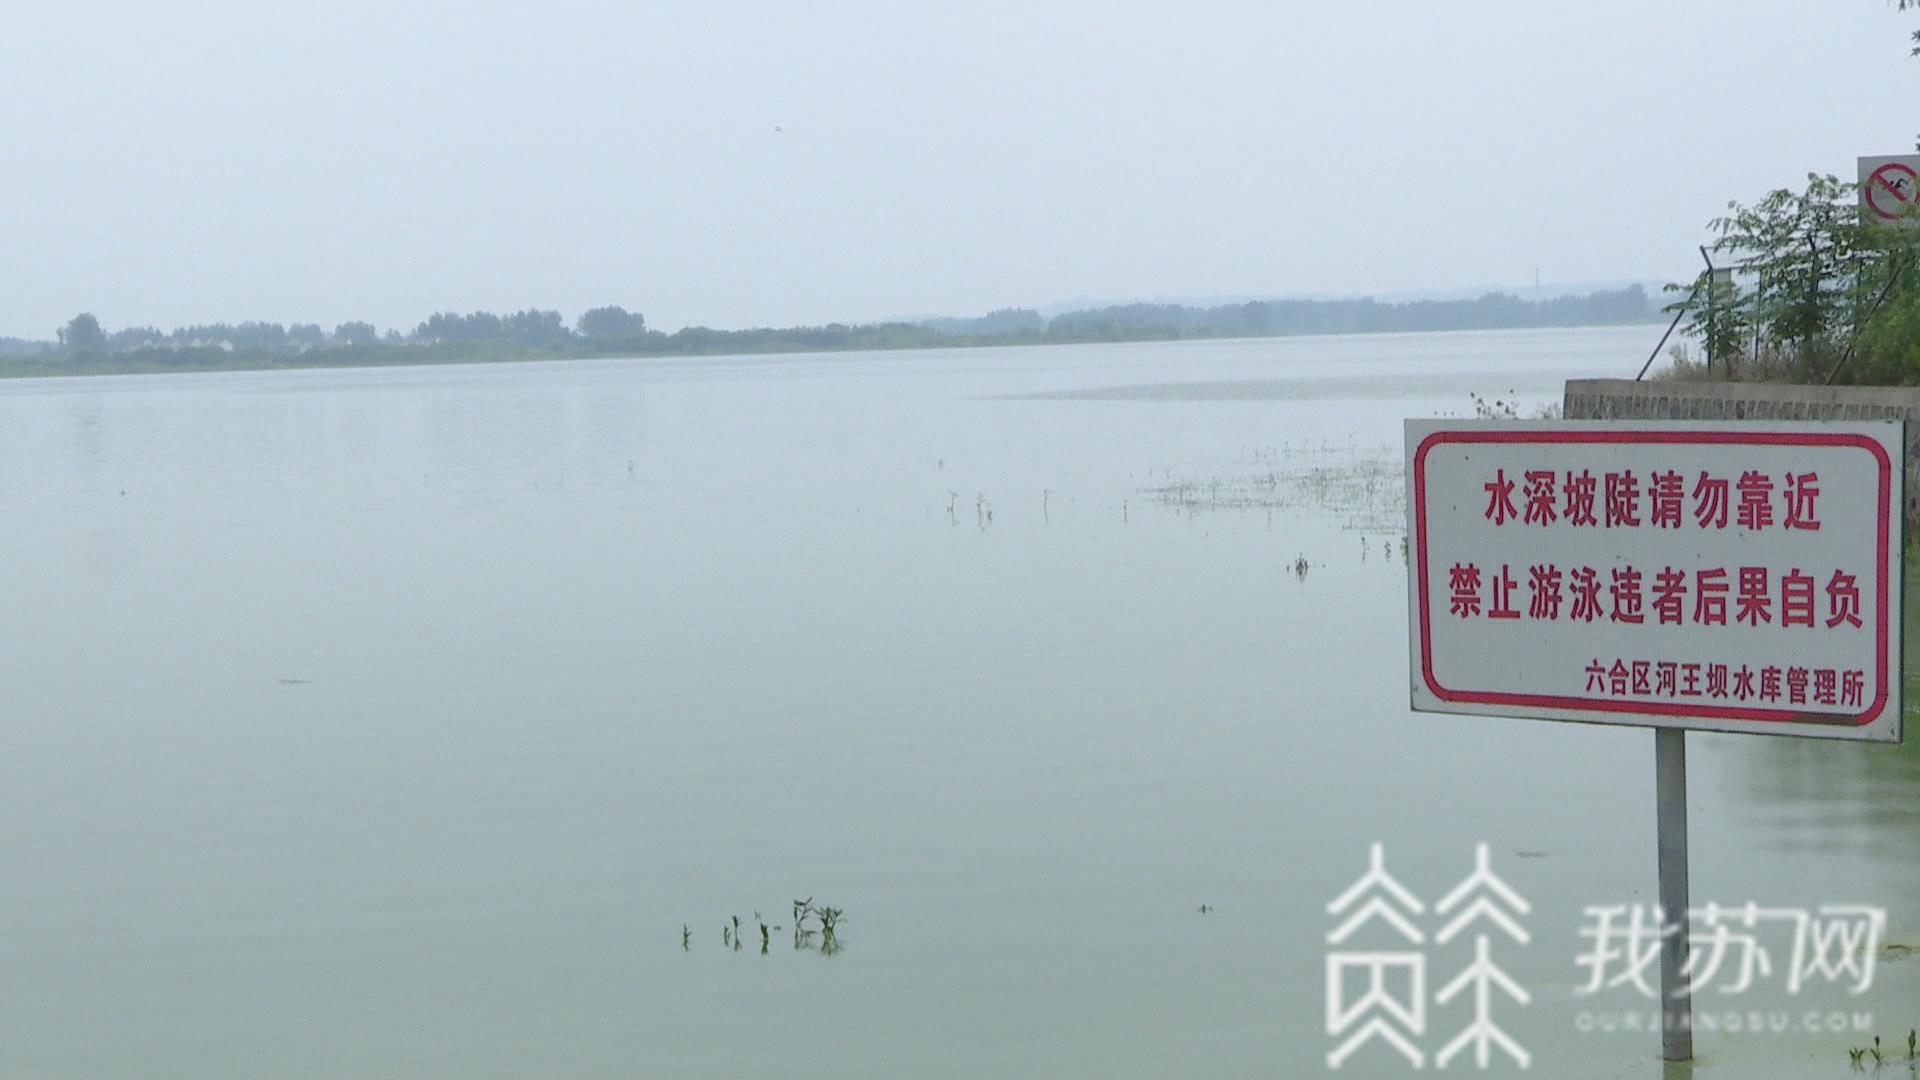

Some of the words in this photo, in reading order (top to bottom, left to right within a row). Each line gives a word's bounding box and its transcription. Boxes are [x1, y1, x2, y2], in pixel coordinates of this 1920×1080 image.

[1484, 468, 1822, 531] 水深坡陡请勿靠近
[1448, 562, 1863, 629] 禁止游泳违者后果自负
[1584, 658, 1865, 707] 六合区河王坝水库管理所
